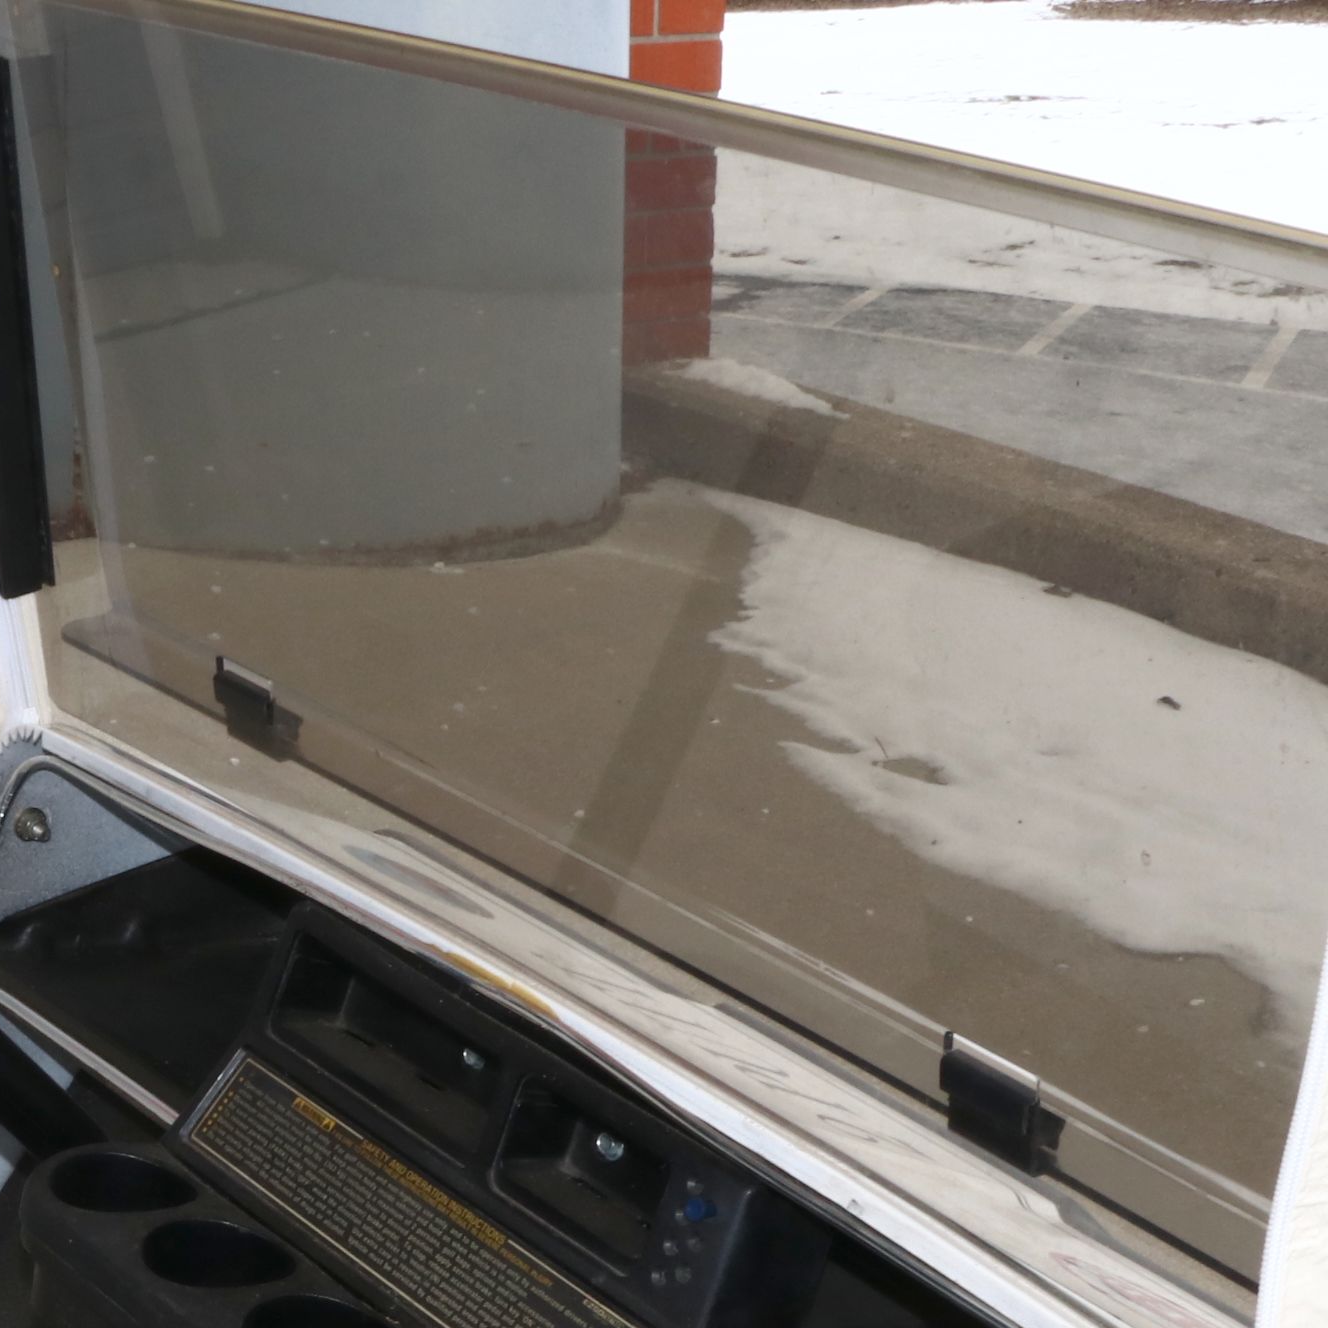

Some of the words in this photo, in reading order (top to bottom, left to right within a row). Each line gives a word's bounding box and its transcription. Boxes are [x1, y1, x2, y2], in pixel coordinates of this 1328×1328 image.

[359, 1138, 391, 1164] SAFETY
[387, 1157, 408, 1176] AND
[403, 1169, 450, 1206] OPERATION
[445, 1198, 508, 1246] INSTRUCTIONS
